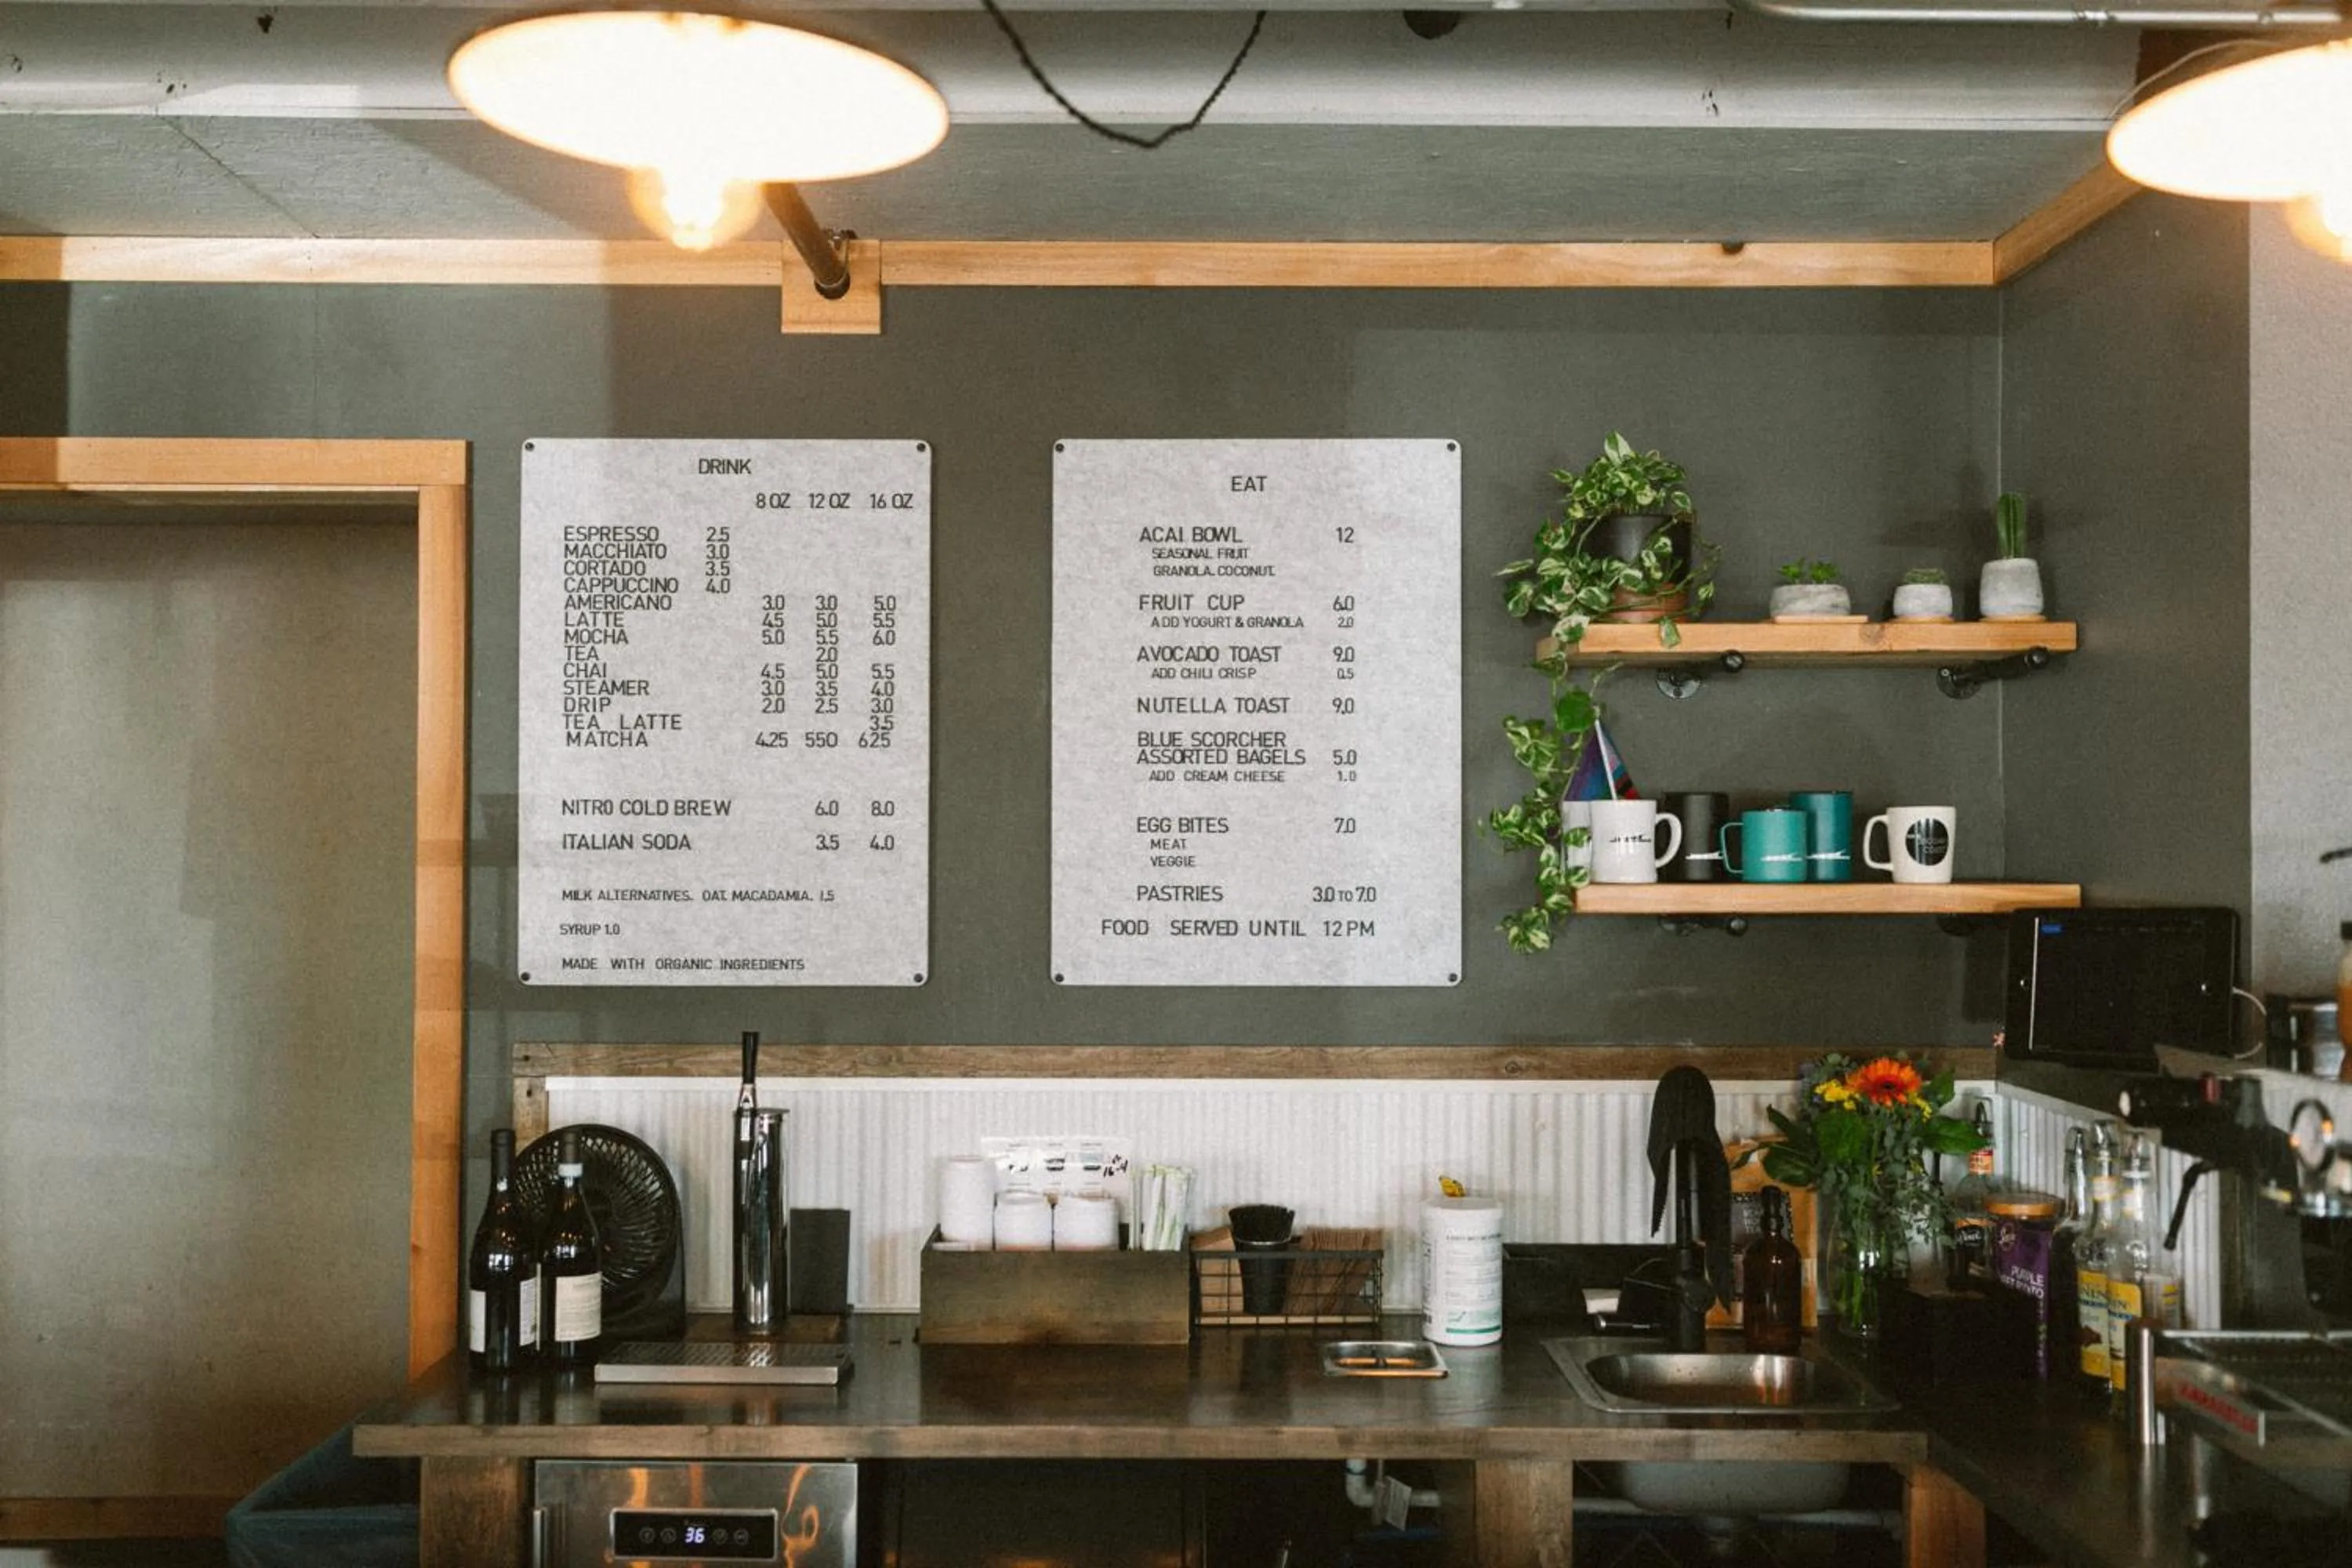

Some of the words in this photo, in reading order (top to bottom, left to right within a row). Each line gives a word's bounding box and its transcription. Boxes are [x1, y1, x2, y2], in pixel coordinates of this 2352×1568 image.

[698, 457, 753, 475] DRINK
[1230, 475, 1268, 492] EAT
[754, 492, 767, 510] 8
[768, 492, 791, 510] OZ
[808, 492, 826, 510] 12
[828, 492, 851, 510] OZ
[869, 492, 887, 510] 16
[891, 492, 914, 510] OZ
[564, 525, 659, 543] ESPRESSO
[706, 526, 730, 543] 2.5
[1192, 526, 1243, 543] BOWL
[1335, 526, 1355, 544] 12
[564, 542, 668, 561] MACCHIATO
[706, 543, 730, 561] 3.0
[1152, 547, 1213, 560] SEASONAL
[1217, 547, 1250, 560] FRUIT
[563, 560, 646, 576] CORTADO
[705, 560, 731, 577] 3.5
[564, 577, 680, 594] CAPPUCCINO
[705, 577, 731, 594] 4.0
[564, 593, 673, 612] AMERICANO
[761, 593, 786, 612] 3.0
[815, 594, 838, 612] 3.0
[873, 594, 897, 612] 5.0
[1138, 593, 1195, 612] FRUIT
[1207, 593, 1245, 612] CUP
[1332, 595, 1356, 612] 6.0
[564, 611, 625, 628] LATTE
[761, 612, 785, 629] 4.5
[816, 612, 838, 629] 5.0
[873, 612, 896, 629] 5.5
[1150, 615, 1180, 628] ADD
[1182, 615, 1232, 628] YOGURT
[1234, 615, 1245, 628] &
[1246, 615, 1305, 628] GRANOLA
[1338, 615, 1355, 629] 2.0
[564, 628, 630, 647] MOCHA
[761, 628, 786, 645] 5.0
[815, 628, 840, 646] 5.5
[872, 629, 896, 647] 6.0
[564, 645, 600, 664] TEA
[815, 646, 839, 663] 2.0
[1136, 645, 1220, 663] AVOCADO
[1229, 645, 1282, 663] TOAST
[1332, 645, 1356, 663] 9.0
[563, 662, 608, 681] CHAI
[760, 662, 786, 681] 4.5
[815, 662, 839, 680] 5.0
[870, 662, 895, 681] 5.5
[1151, 667, 1177, 680] ADD
[1180, 667, 1213, 680] CHILI
[1218, 667, 1257, 680] CRISP
[1337, 667, 1355, 680] 0.5
[563, 679, 651, 698] STEAMER
[761, 679, 786, 697] 3.0
[815, 680, 839, 697] 3.5
[869, 680, 895, 697] 4.0
[561, 696, 612, 716] DRIP
[760, 697, 786, 714] 2.0
[815, 697, 839, 714] 2.5
[871, 697, 894, 714] 3.0
[1137, 696, 1228, 714] NUTELLA
[1233, 696, 1291, 714] TOAST
[1331, 697, 1356, 716] 9.0
[562, 713, 603, 732] TEA
[619, 713, 683, 732] LATTE
[869, 714, 895, 731] 3.5
[565, 730, 649, 748] MATCHA
[754, 731, 789, 749] 4.25
[1137, 730, 1184, 748] BLUE
[1190, 731, 1287, 748] SCORCHER
[1136, 748, 1229, 765] ASSORTED
[1236, 748, 1307, 766] BAGELS
[1332, 749, 1358, 766] 5.0
[1149, 770, 1175, 782] ADD
[1183, 769, 1229, 782] CREAM
[1233, 770, 1285, 783] CHEESE
[1337, 770, 1357, 782] 1.0
[561, 798, 614, 816] NITRO
[619, 798, 670, 816] COLD
[673, 799, 732, 817] BREW
[815, 799, 840, 817] 6.0
[871, 800, 895, 817] 8.0
[1136, 816, 1172, 833] EGG
[1178, 816, 1230, 834] BITES
[1334, 816, 1356, 834] 7.0
[561, 833, 634, 851] ITALIAN
[641, 833, 692, 851] SODA
[815, 833, 840, 851] 3.5
[869, 833, 895, 851] 4.0
[1150, 838, 1187, 851] MEAT
[1149, 855, 1196, 868] VEGGIE
[561, 889, 593, 902] MILK
[1136, 884, 1225, 903] PASTRIES
[1312, 885, 1336, 903] 3.0
[1338, 890, 1354, 902] TO
[1355, 885, 1377, 903] 7.0
[559, 923, 601, 936] SYRUP
[604, 923, 621, 936] 1.0
[1102, 918, 1150, 937] FOOD
[1170, 919, 1240, 937] SERVED
[1249, 920, 1307, 937] UNTIL
[1323, 920, 1343, 937] 12
[1346, 920, 1375, 937] PM
[561, 957, 598, 971] MADE
[610, 957, 645, 970] WITH
[655, 957, 713, 971] ORGANIC
[719, 957, 805, 971] INGREDIENTS
[684, 1526, 706, 1544] 36
